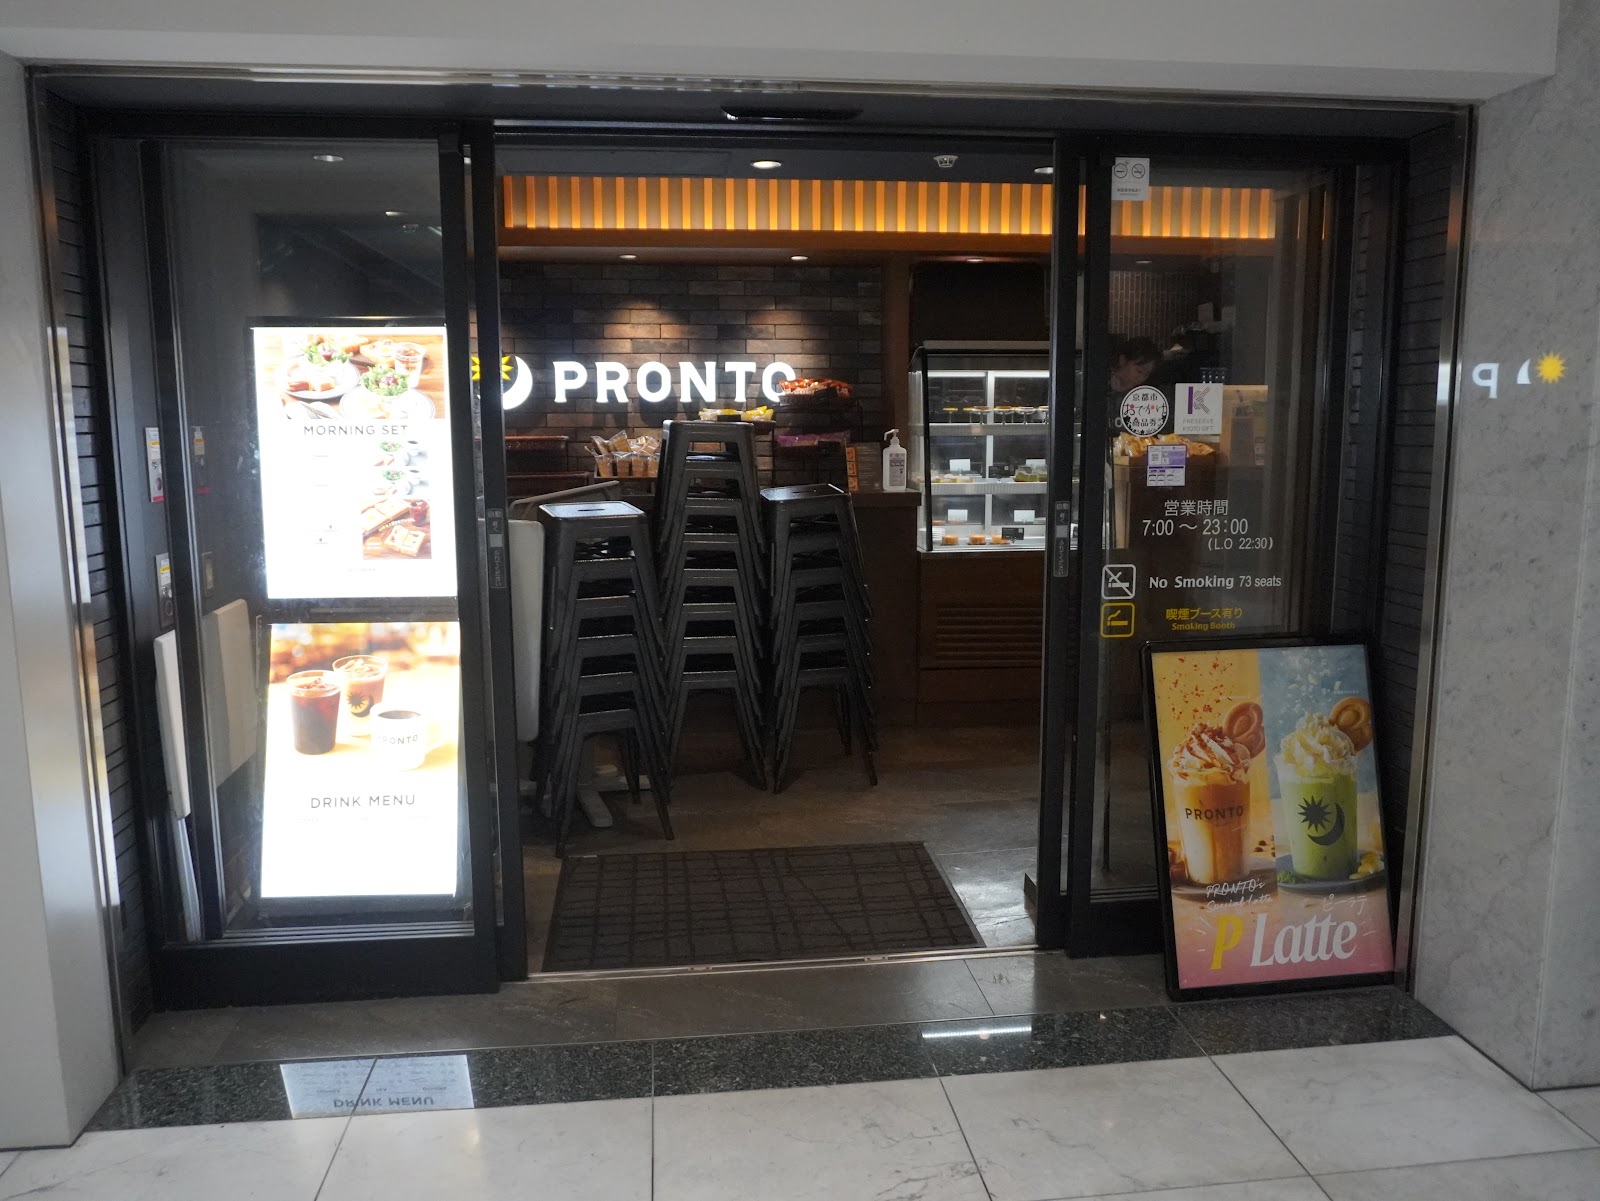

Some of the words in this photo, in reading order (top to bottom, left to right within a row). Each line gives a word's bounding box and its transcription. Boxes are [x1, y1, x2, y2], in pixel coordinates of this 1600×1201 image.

[552, 360, 797, 404] PRONTO
[1132, 392, 1158, 402] 京都市
[303, 424, 376, 436] MORNING
[382, 424, 408, 435] SET
[1164, 499, 1229, 517] 営業時間
[1142, 519, 1174, 536] 7:00
[1202, 518, 1249, 536] 23:00
[1238, 536, 1274, 550] 22:30)
[1149, 576, 1168, 589] No
[1174, 575, 1235, 589] Smoking
[1239, 575, 1252, 588] 73
[1254, 575, 1282, 587] seats
[1165, 607, 1243, 620] 喫煙ブース有り
[1171, 621, 1209, 632] Smoking
[1210, 621, 1236, 630] Booth
[378, 734, 418, 745] RONTO
[310, 796, 361, 809] DRINK
[369, 794, 416, 807] MENU
[1184, 804, 1245, 821] PRONTO
[1210, 914, 1245, 970] P
[1249, 913, 1359, 967] Latte
